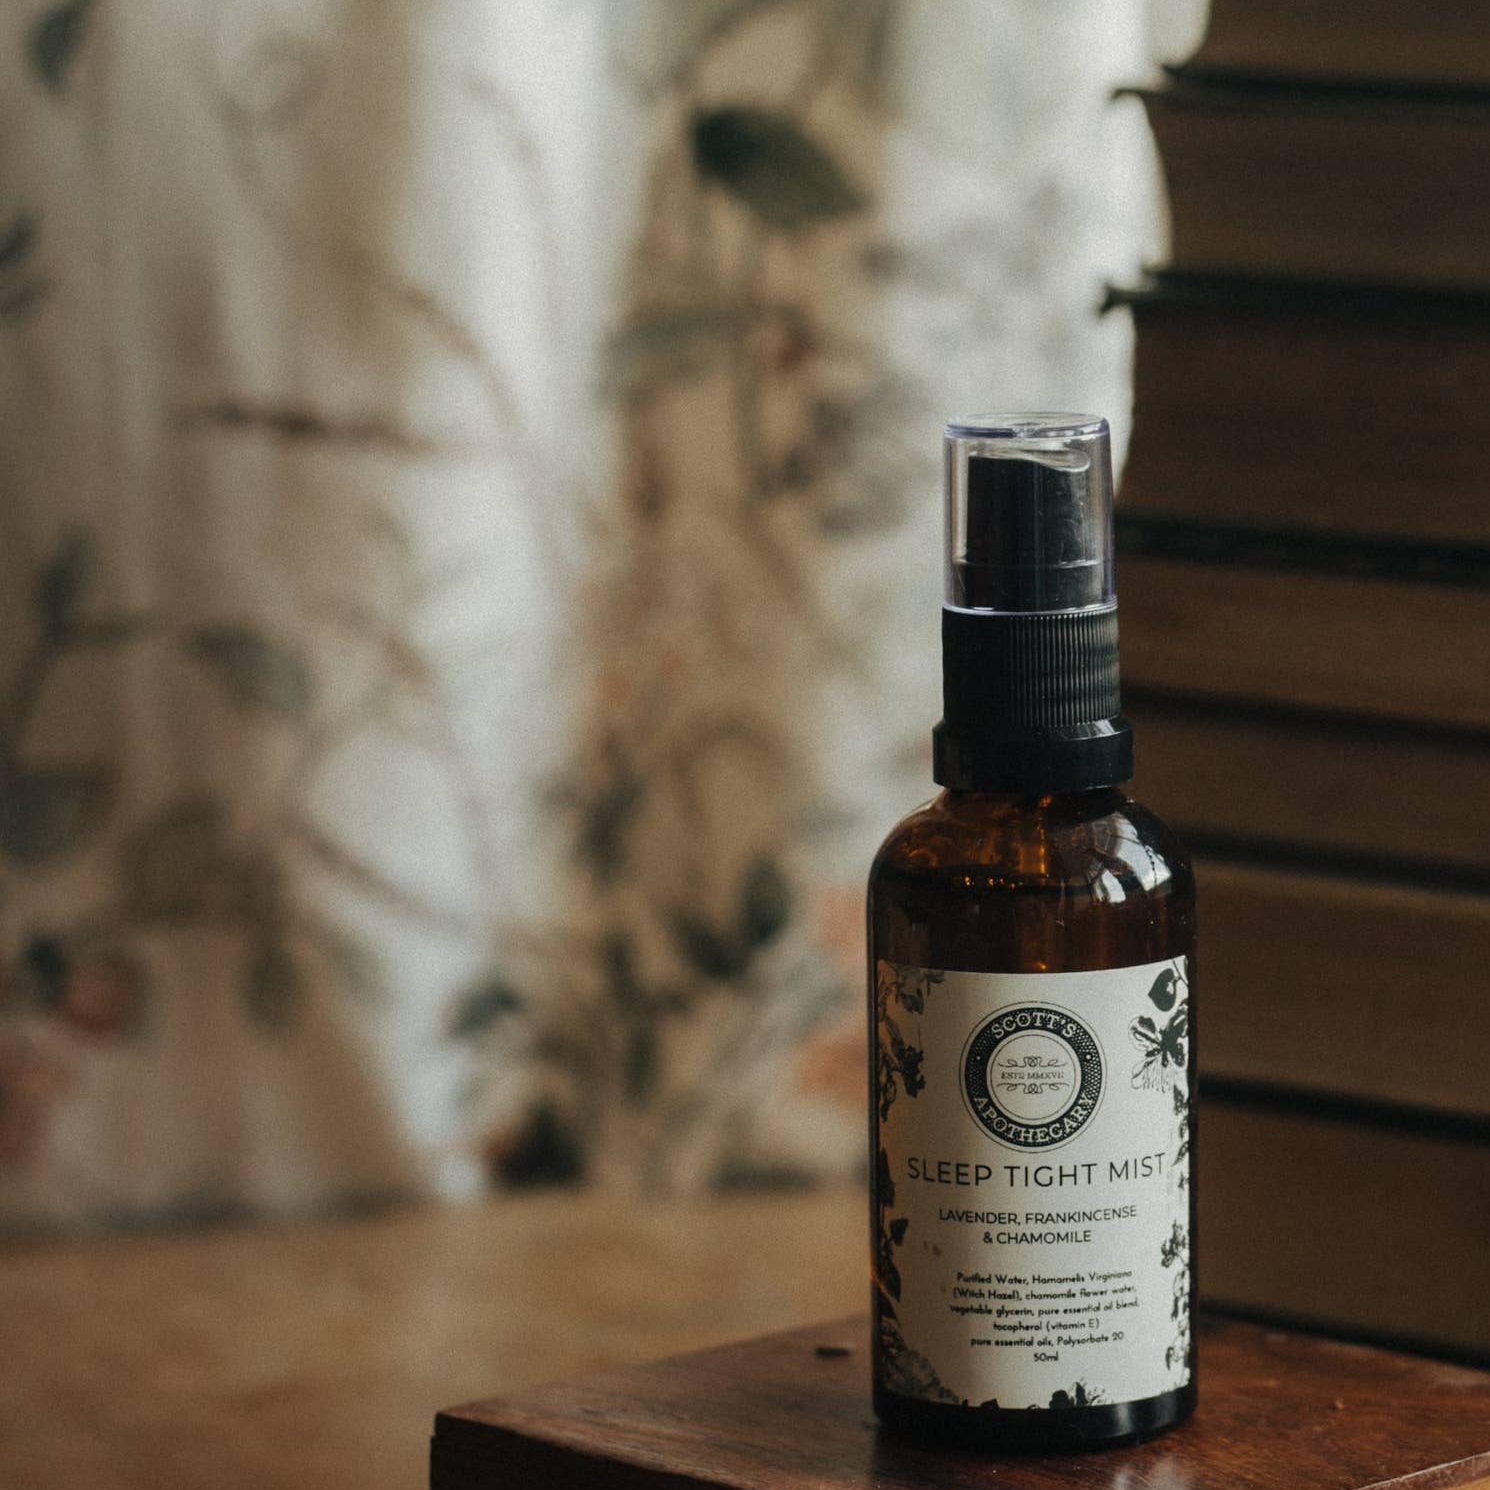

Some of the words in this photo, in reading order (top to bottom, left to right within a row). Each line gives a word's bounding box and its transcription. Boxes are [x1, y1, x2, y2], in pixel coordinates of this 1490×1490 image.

[991, 1012, 1077, 1038] SCOTT'S
[973, 1092, 1093, 1142] APOTHECARY
[907, 1157, 993, 1186] SLEEP
[1003, 1162, 1098, 1188] TIGHT
[1109, 1152, 1166, 1182] MIST
[939, 1208, 1021, 1226] LAVENDER,
[1025, 1205, 1138, 1225] FRANKINCENSE
[983, 1232, 993, 1244] &
[996, 1229, 1092, 1245] CHAMOMILE
[957, 1271, 992, 1284] Purified
[995, 1273, 1029, 1285] Water,
[1032, 1272, 1085, 1284] Hamamelis
[1088, 1270, 1132, 1283] Virginiana
[953, 1287, 985, 1299] (Witch
[988, 1289, 1022, 1301] Hazel),
[1025, 1288, 1077, 1300] chamomile
[1079, 1287, 1108, 1298] flower
[1111, 1285, 1137, 1294] water,
[949, 1303, 993, 1316] vegetable
[996, 1304, 1035, 1318] glycerin,
[1038, 1308, 1059, 1317] pure
[1063, 1302, 1101, 1314] essential
[1103, 1300, 1113, 1311] oil
[993, 1320, 1042, 1333] tocopherol
[1046, 1320, 1086, 1332] (vitamin
[1088, 1317, 1100, 1331] E)
[970, 1338, 992, 1348] pure
[994, 1335, 1034, 1347] essential
[1036, 1335, 1054, 1347] oils,
[1057, 1333, 1109, 1348] Polysorbate
[1111, 1331, 1124, 1341] 20
[1033, 1350, 1059, 1362] 50ml
